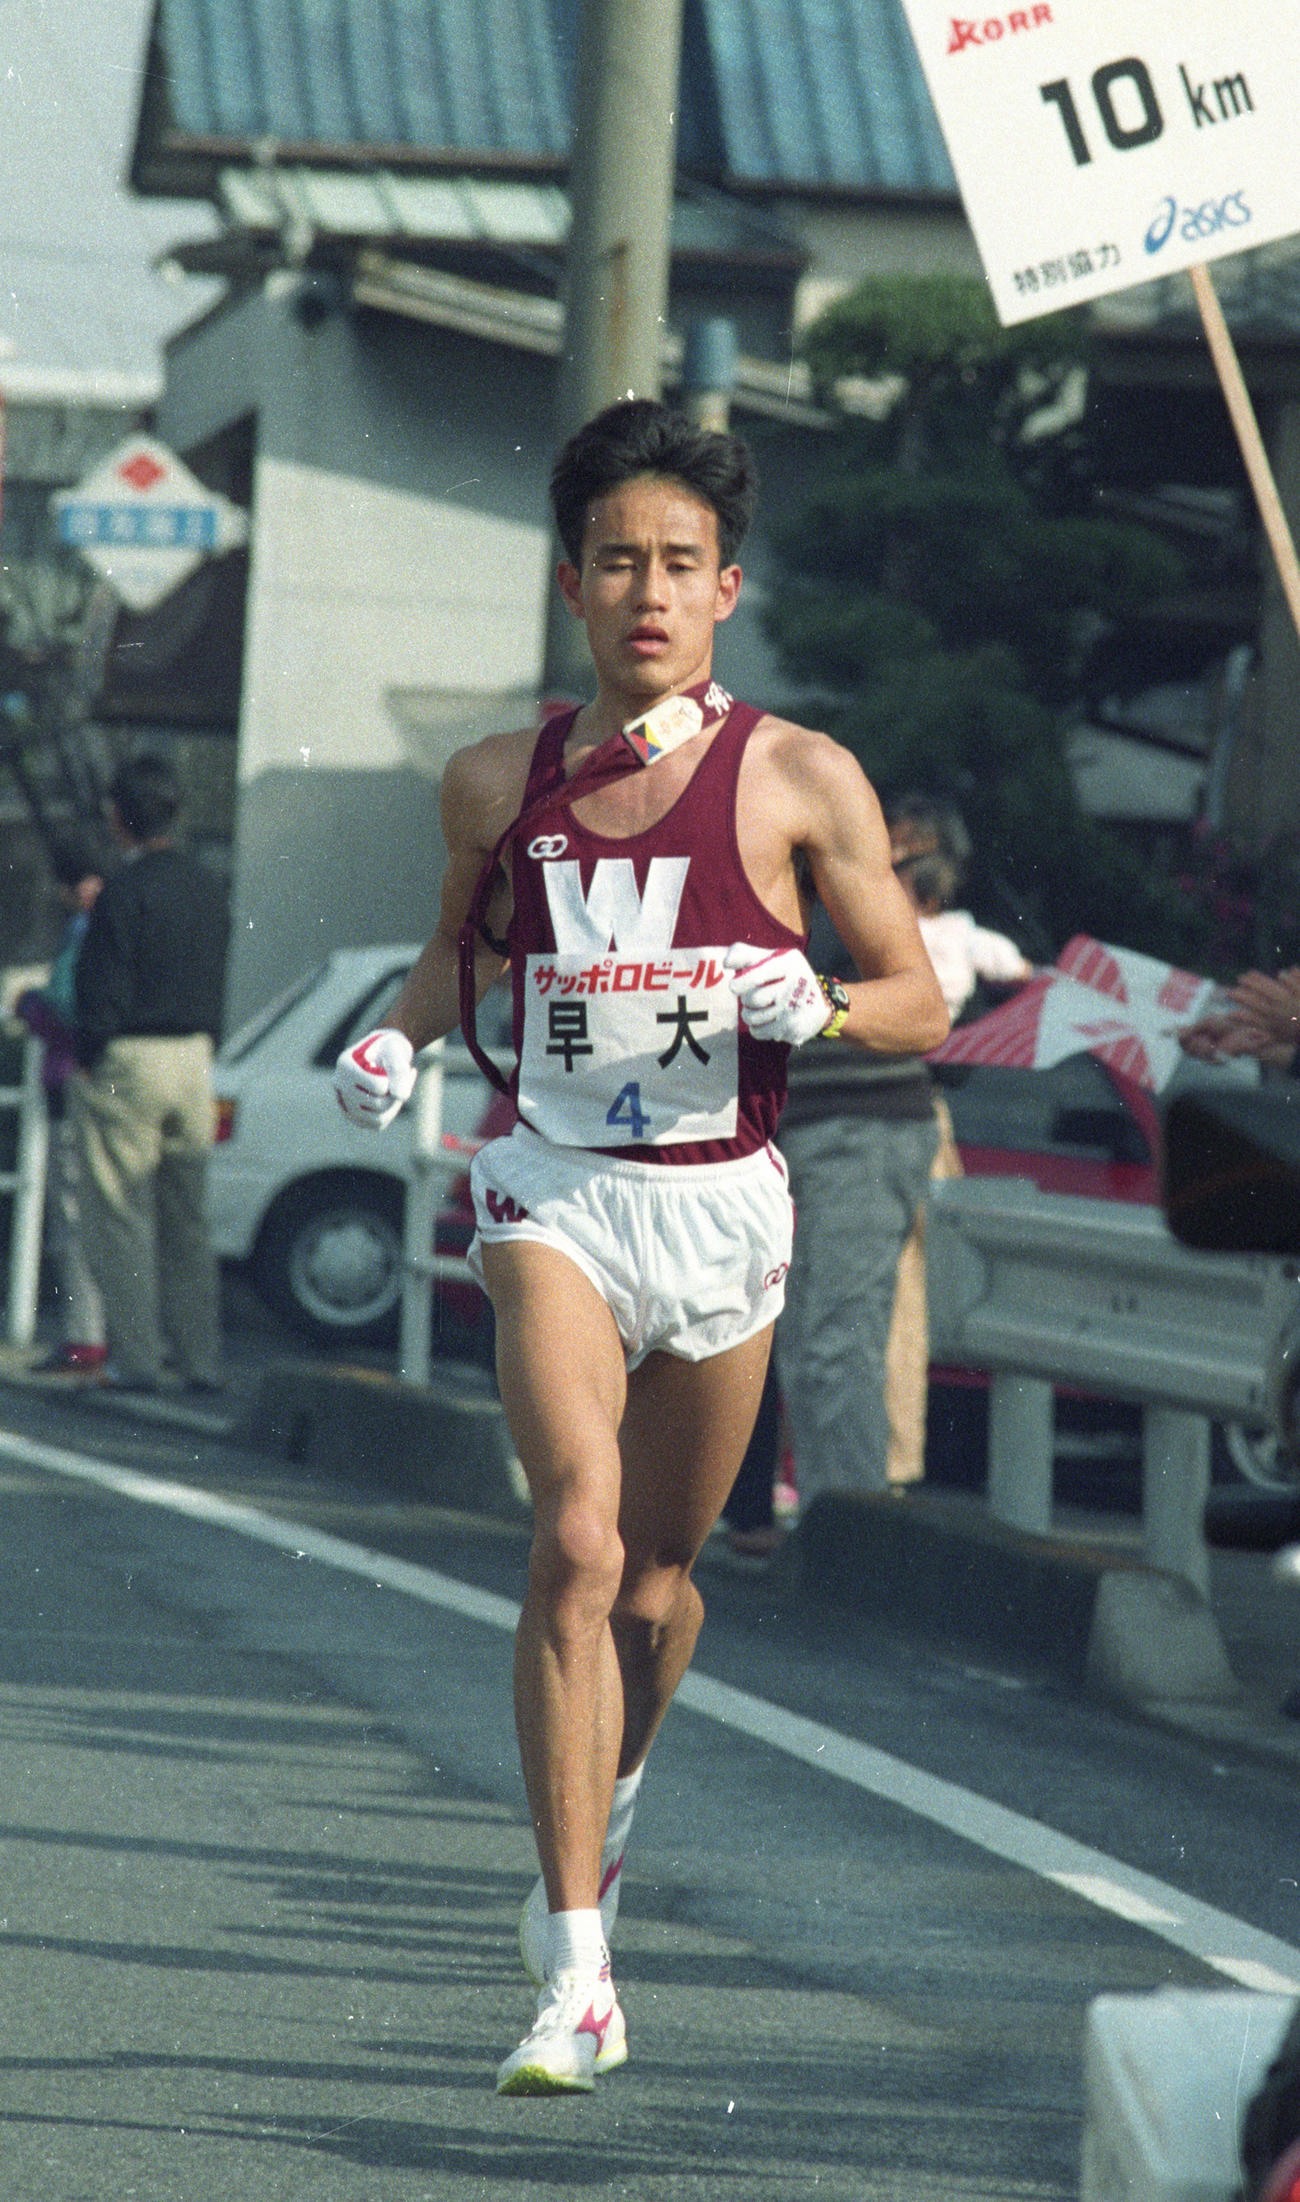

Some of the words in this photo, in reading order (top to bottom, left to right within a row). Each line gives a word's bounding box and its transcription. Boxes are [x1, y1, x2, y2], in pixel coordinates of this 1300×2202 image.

[1039, 57, 1164, 167] 10
[1178, 62, 1254, 128] km
[1013, 243, 1121, 295] 特別協力
[542, 856, 691, 953] W
[534, 959, 724, 995] サッポロビール
[606, 1082, 650, 1138] 4
